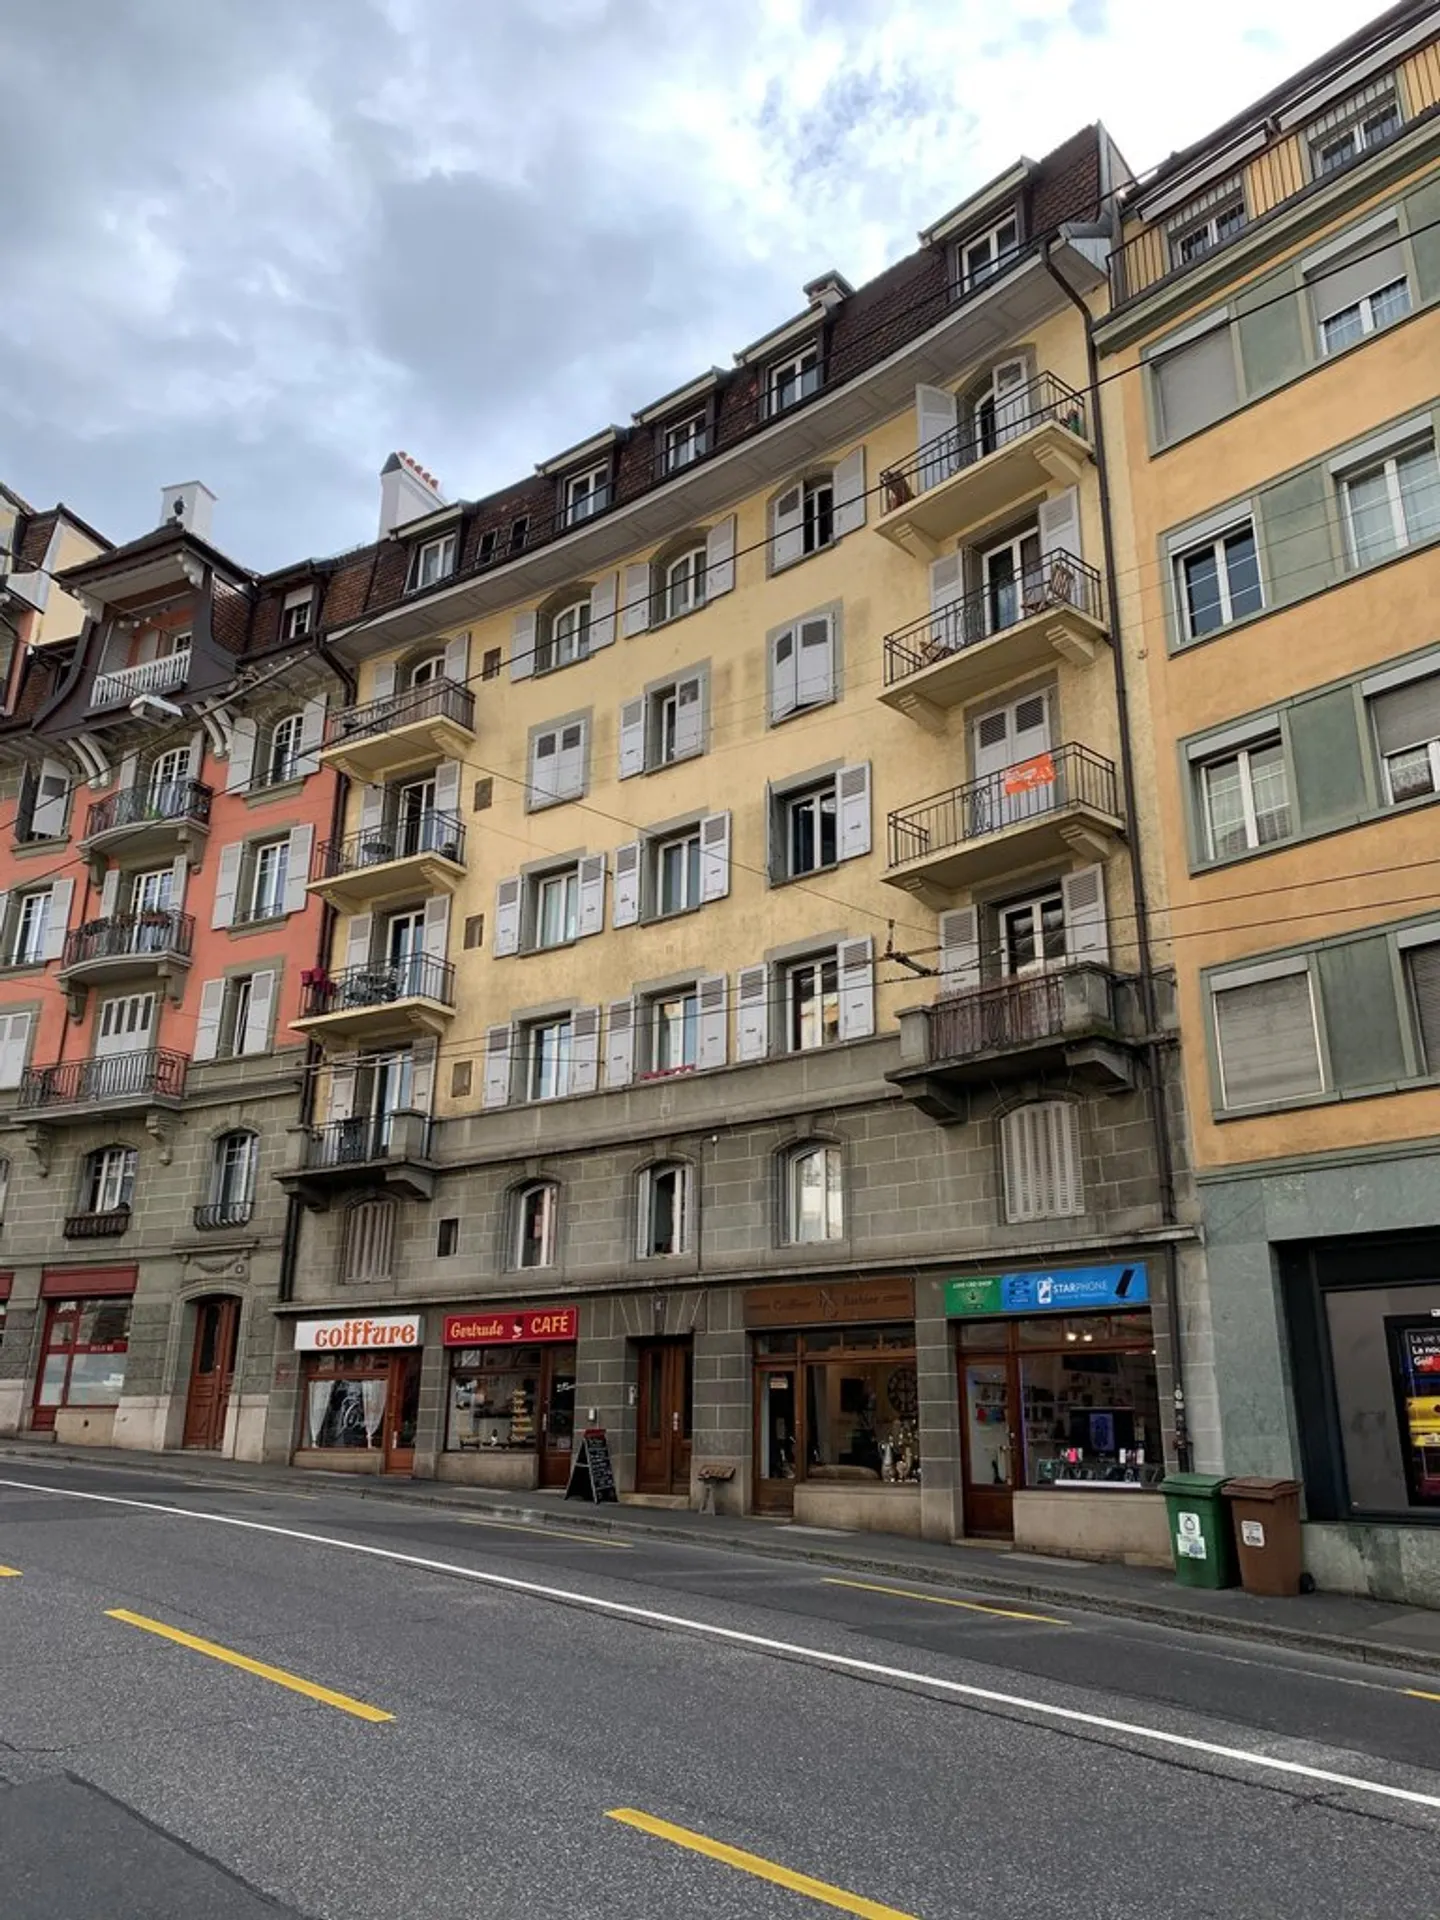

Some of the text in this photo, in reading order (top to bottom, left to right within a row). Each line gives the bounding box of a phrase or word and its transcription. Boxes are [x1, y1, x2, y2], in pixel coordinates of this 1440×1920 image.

[1053, 1279, 1107, 1294] STARPHONE
[314, 1320, 415, 1347] coiffure
[450, 1309, 569, 1338] Gertrude CAFÉ
